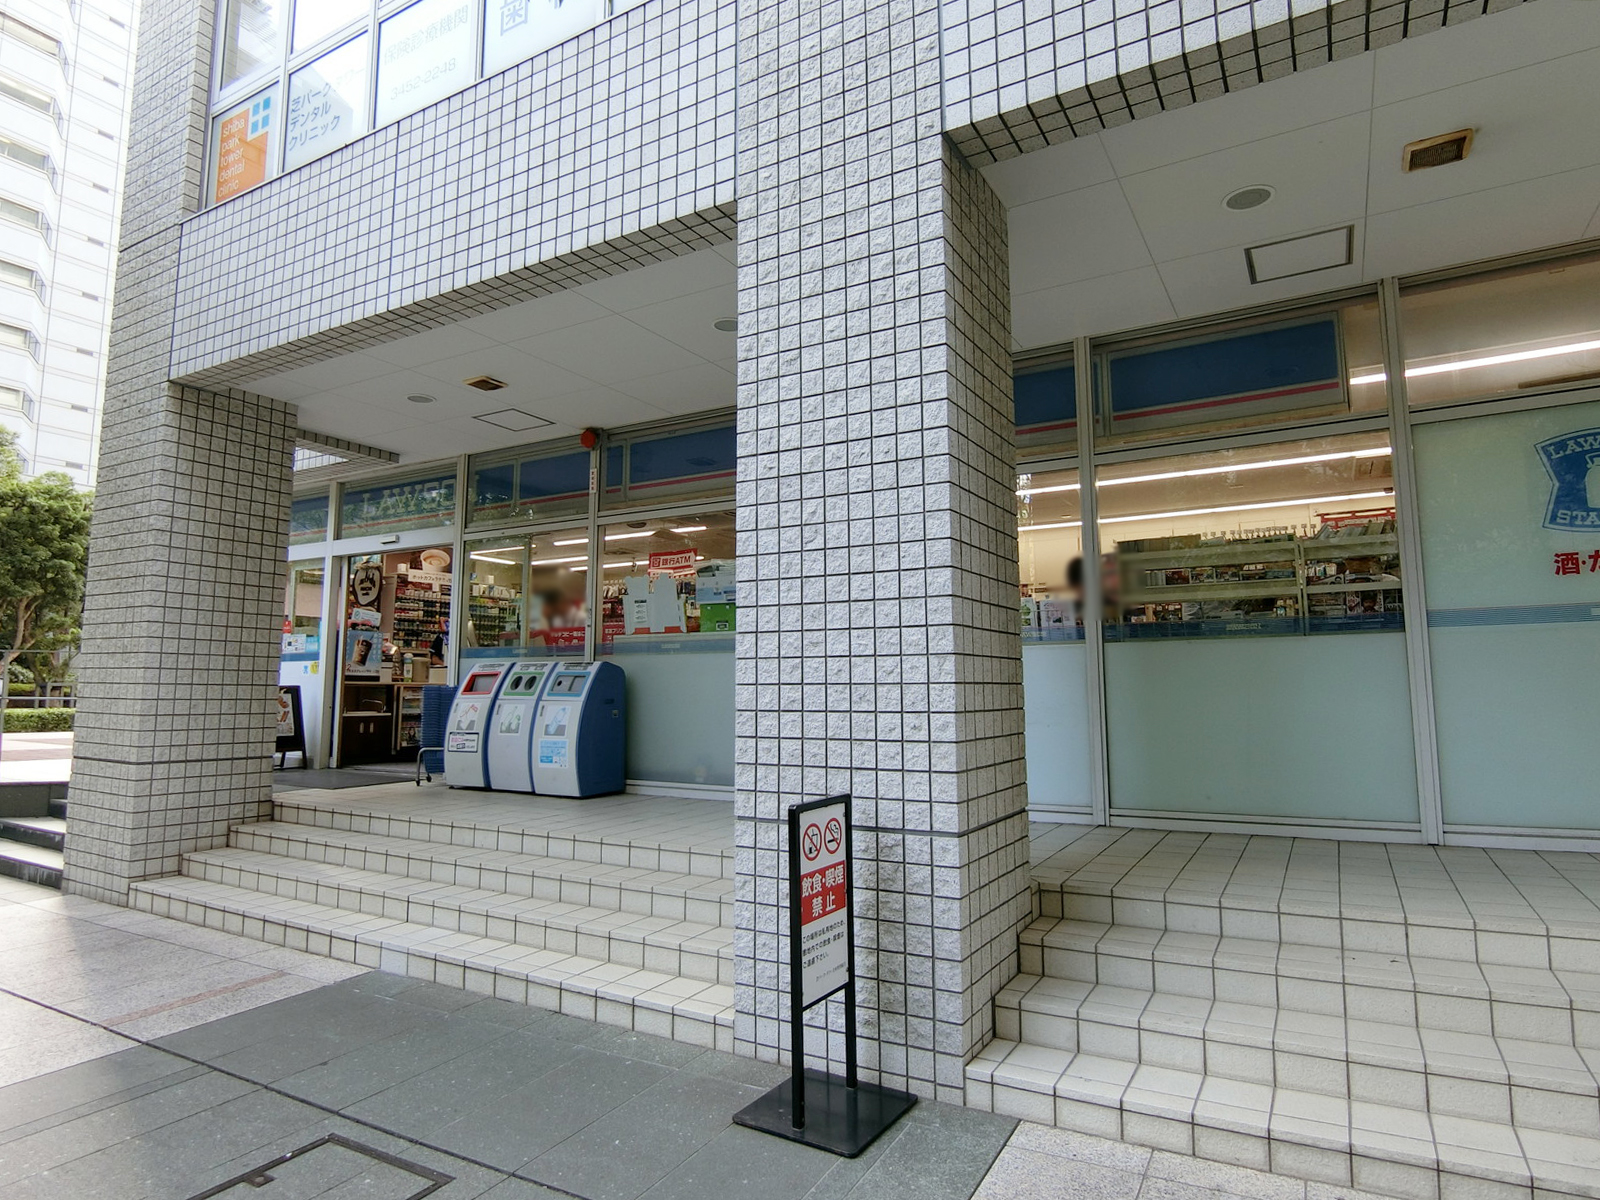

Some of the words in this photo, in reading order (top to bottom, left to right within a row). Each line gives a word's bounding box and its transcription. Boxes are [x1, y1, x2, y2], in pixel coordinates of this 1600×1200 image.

[384, 4, 468, 65] 保険診療機関
[390, 57, 456, 100] 3452-2248
[223, 118, 245, 138] shiba
[290, 101, 332, 132] デンタル
[221, 134, 240, 155] park
[289, 115, 341, 151] クリニック
[219, 159, 245, 182] dental
[220, 147, 244, 167] tower
[218, 179, 239, 198] clinic
[362, 477, 478, 518] LAWSO
[661, 555, 691, 567] 銀行ATM
[801, 863, 844, 898] 飲食・喫煙
[811, 890, 837, 918] 禁止
